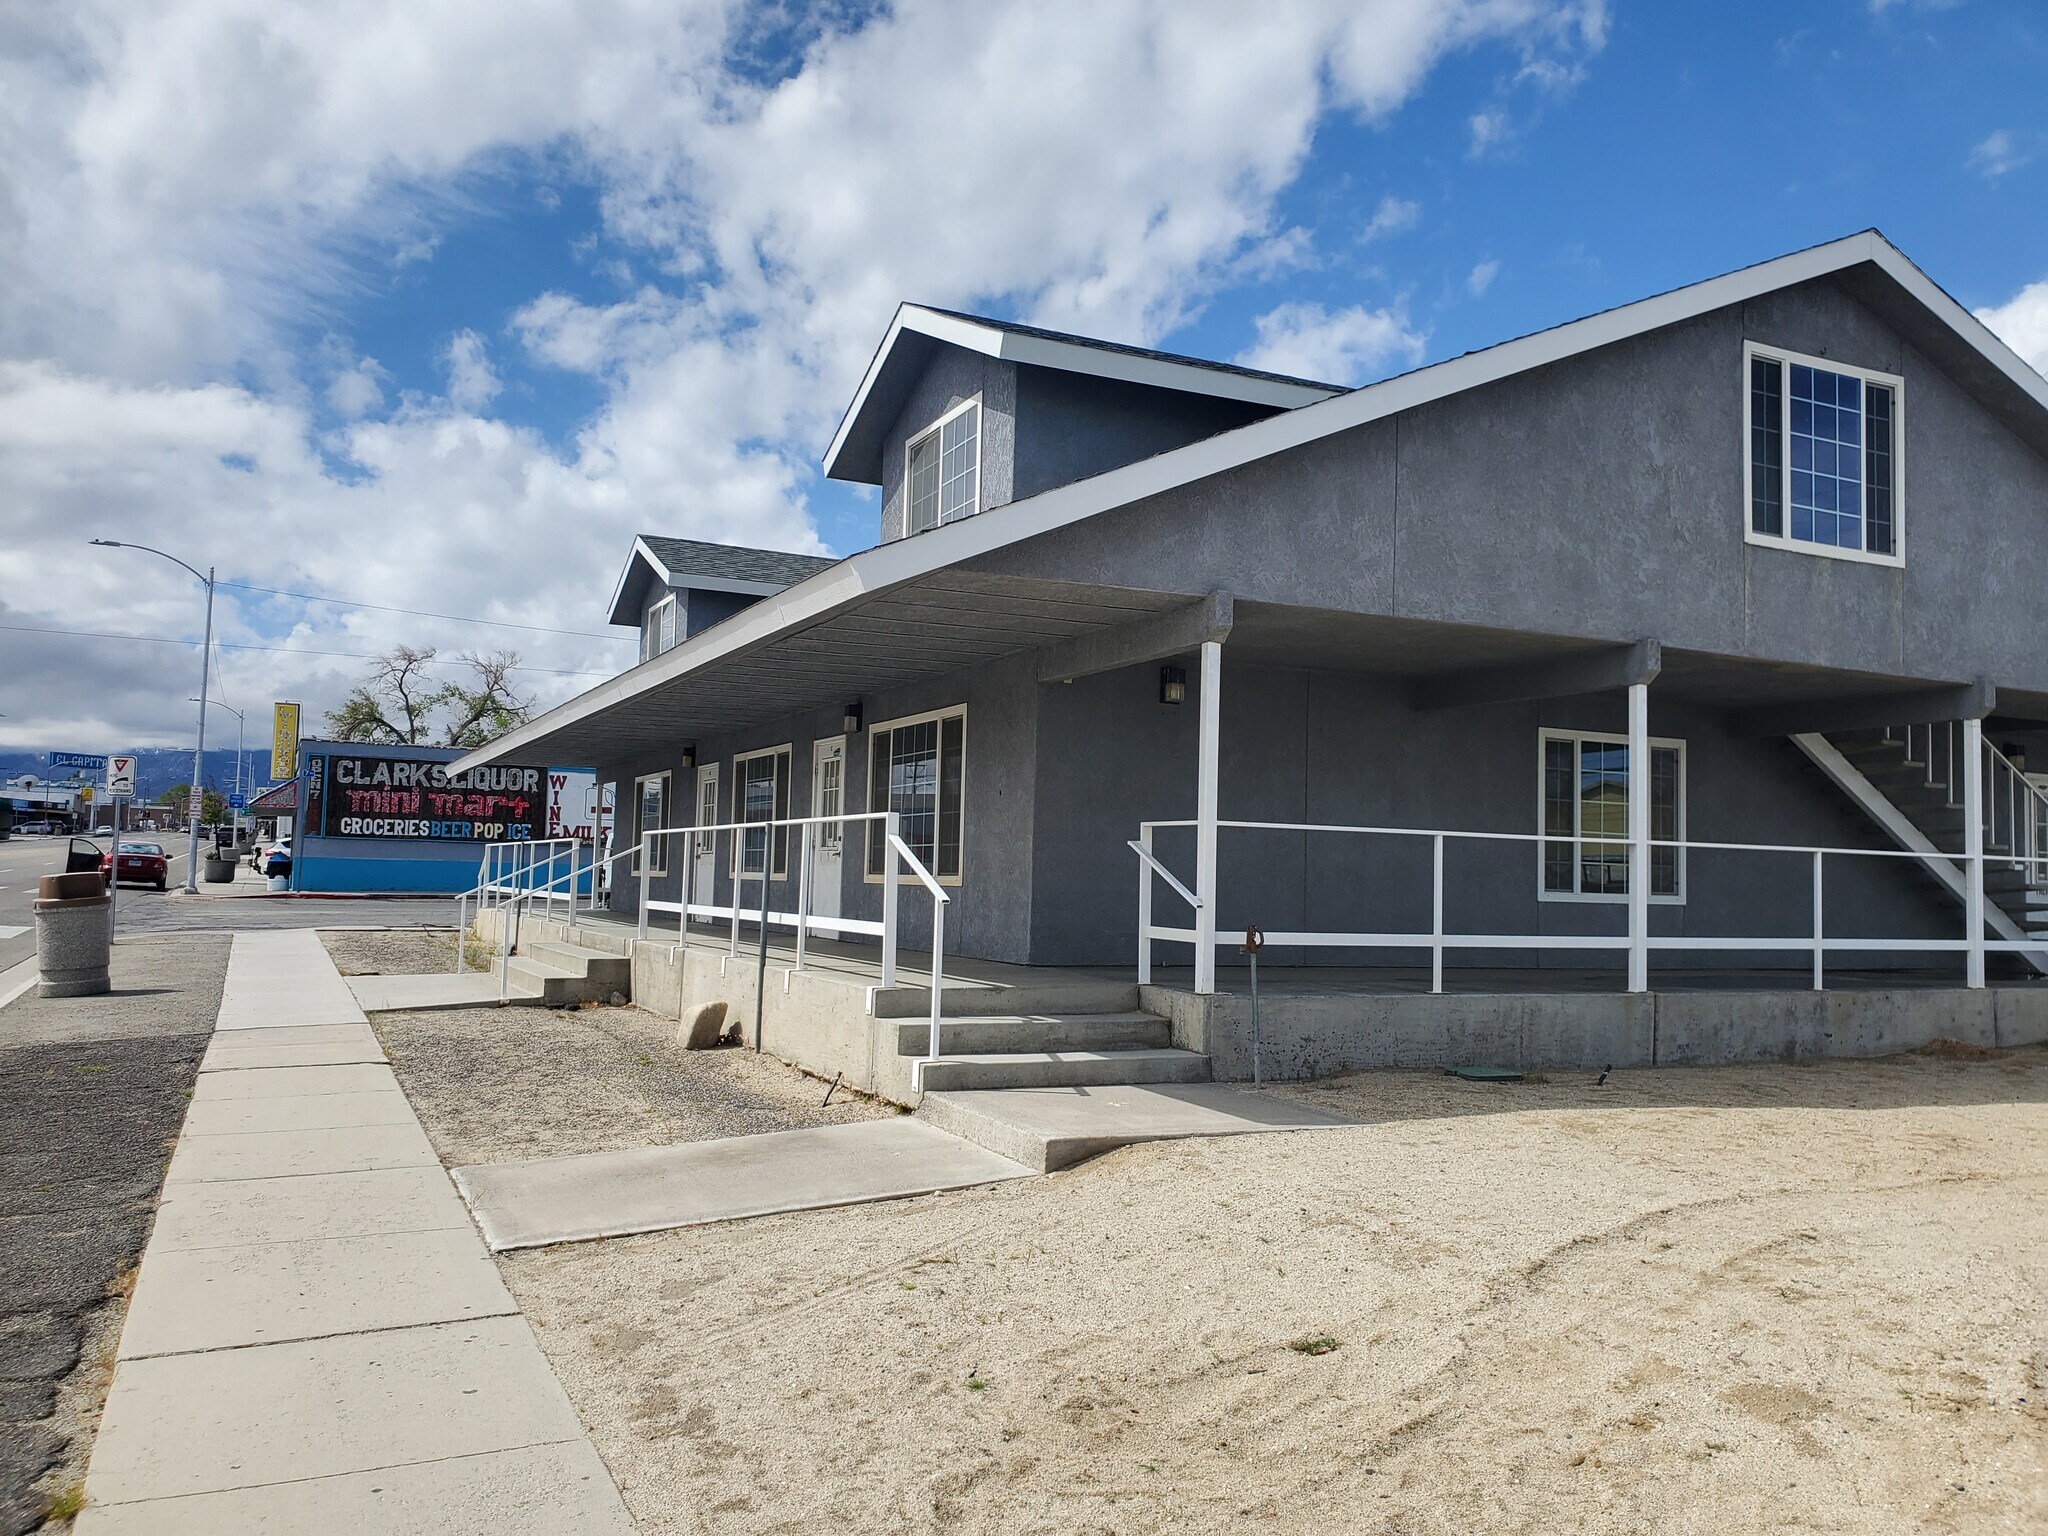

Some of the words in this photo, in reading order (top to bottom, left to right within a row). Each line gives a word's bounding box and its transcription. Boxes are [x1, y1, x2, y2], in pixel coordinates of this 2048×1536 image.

[56, 754, 68, 764] EL
[72, 756, 108, 768] CAPITA
[450, 766, 540, 794] LIQUOR
[547, 775, 568, 839] WINE
[340, 817, 431, 837] GROCERIES
[430, 819, 473, 839] BEER
[473, 821, 505, 840] POP
[506, 823, 532, 841] ICE
